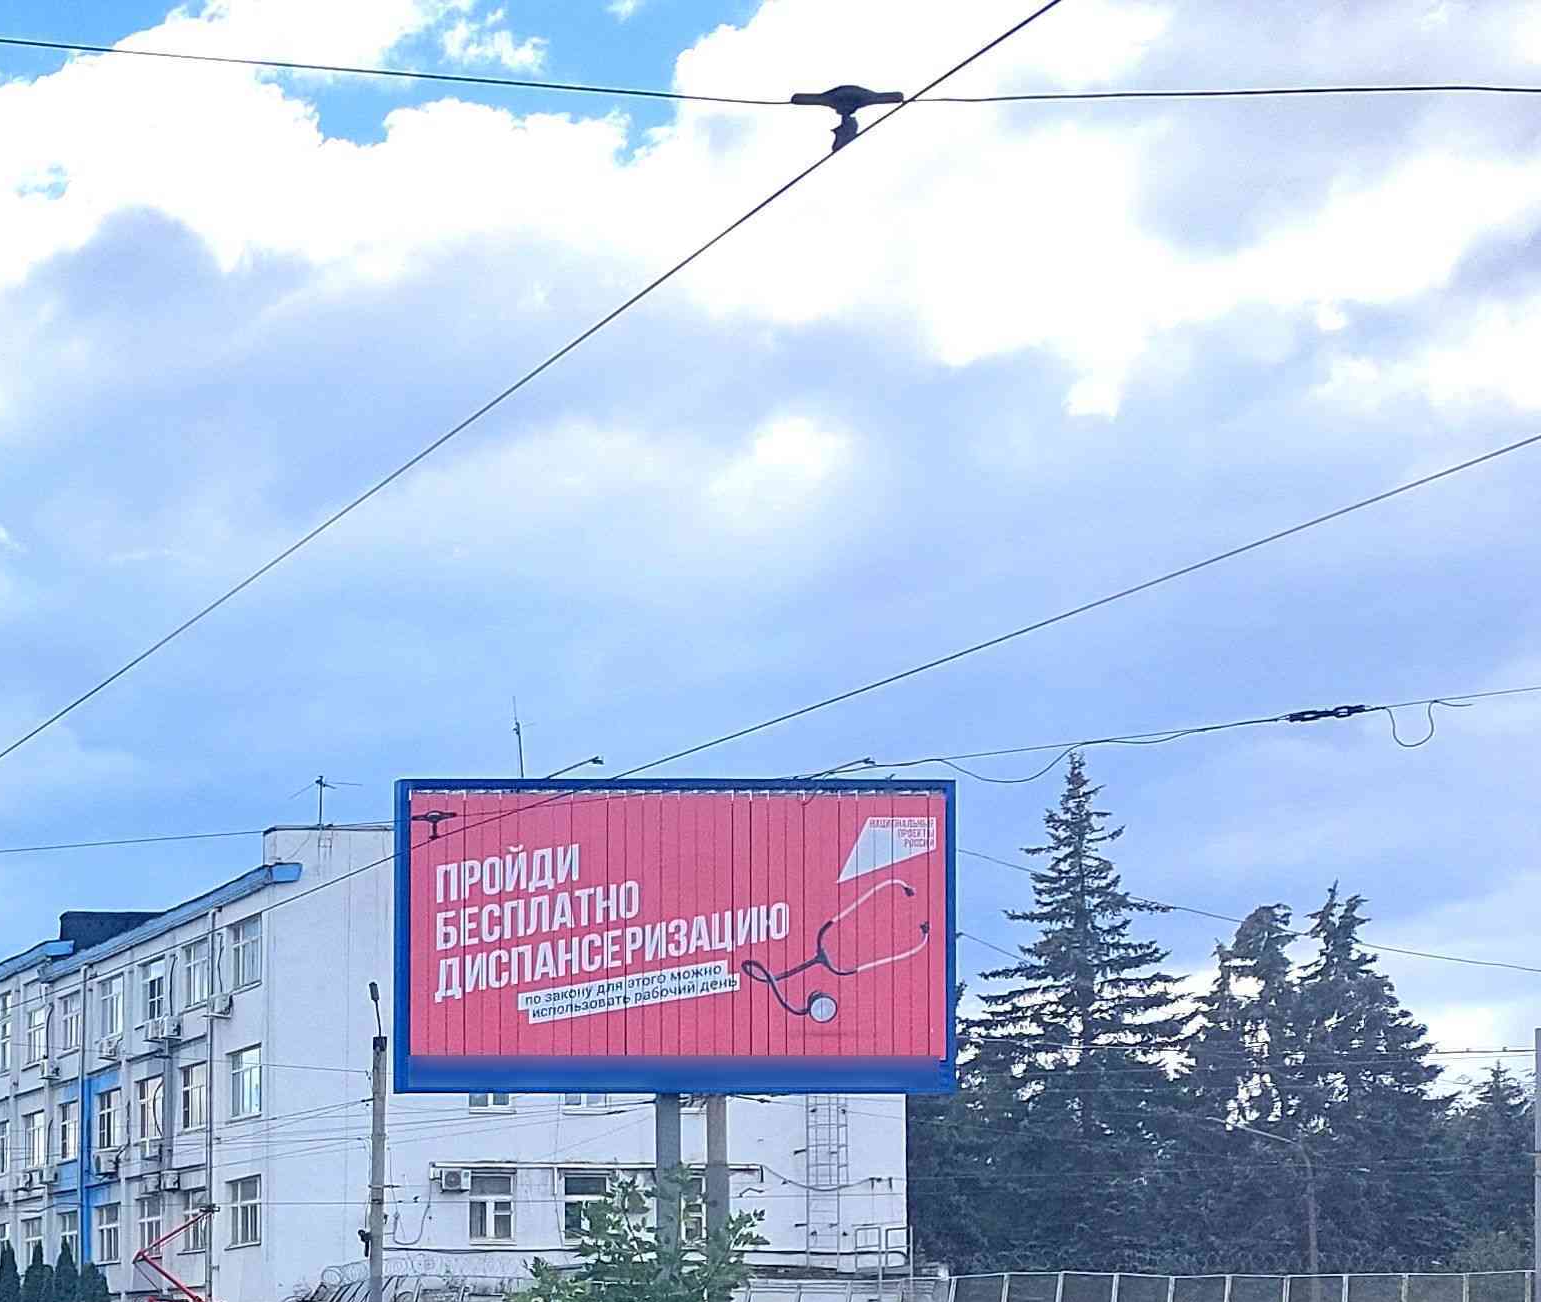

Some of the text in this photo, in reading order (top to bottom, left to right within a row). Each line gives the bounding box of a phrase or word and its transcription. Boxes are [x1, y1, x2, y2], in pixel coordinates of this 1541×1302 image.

[435, 843, 579, 904] ПРОЙДИ
[435, 880, 640, 951] БЕСПЛАТНО
[434, 902, 790, 1003] ДИСПАНСЕРИЗАЦИЮ
[524, 965, 722, 1006] по закону для этого можно
[532, 978, 737, 1019] использовать рабочий день
